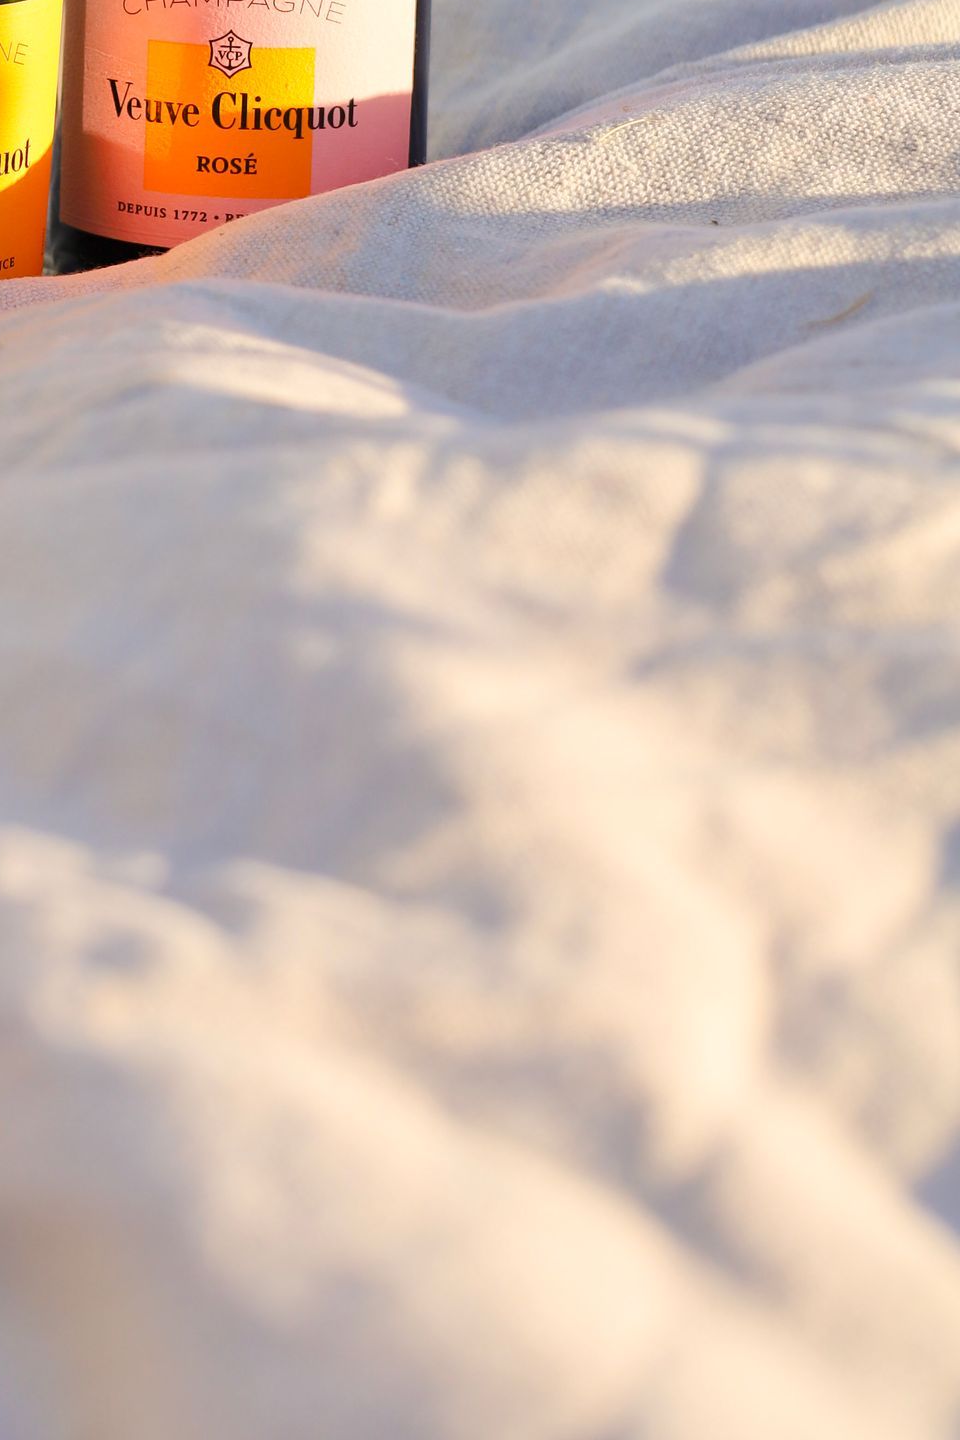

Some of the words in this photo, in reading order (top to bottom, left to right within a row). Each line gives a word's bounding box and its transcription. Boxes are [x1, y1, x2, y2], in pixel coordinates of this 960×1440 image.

[218, 50, 243, 61] VCP
[107, 78, 200, 127] Veuve
[211, 90, 359, 139] Clicquot
[196, 153, 258, 175] ROSÉ
[118, 201, 167, 218] DEPUIS
[174, 209, 208, 222] 1772
